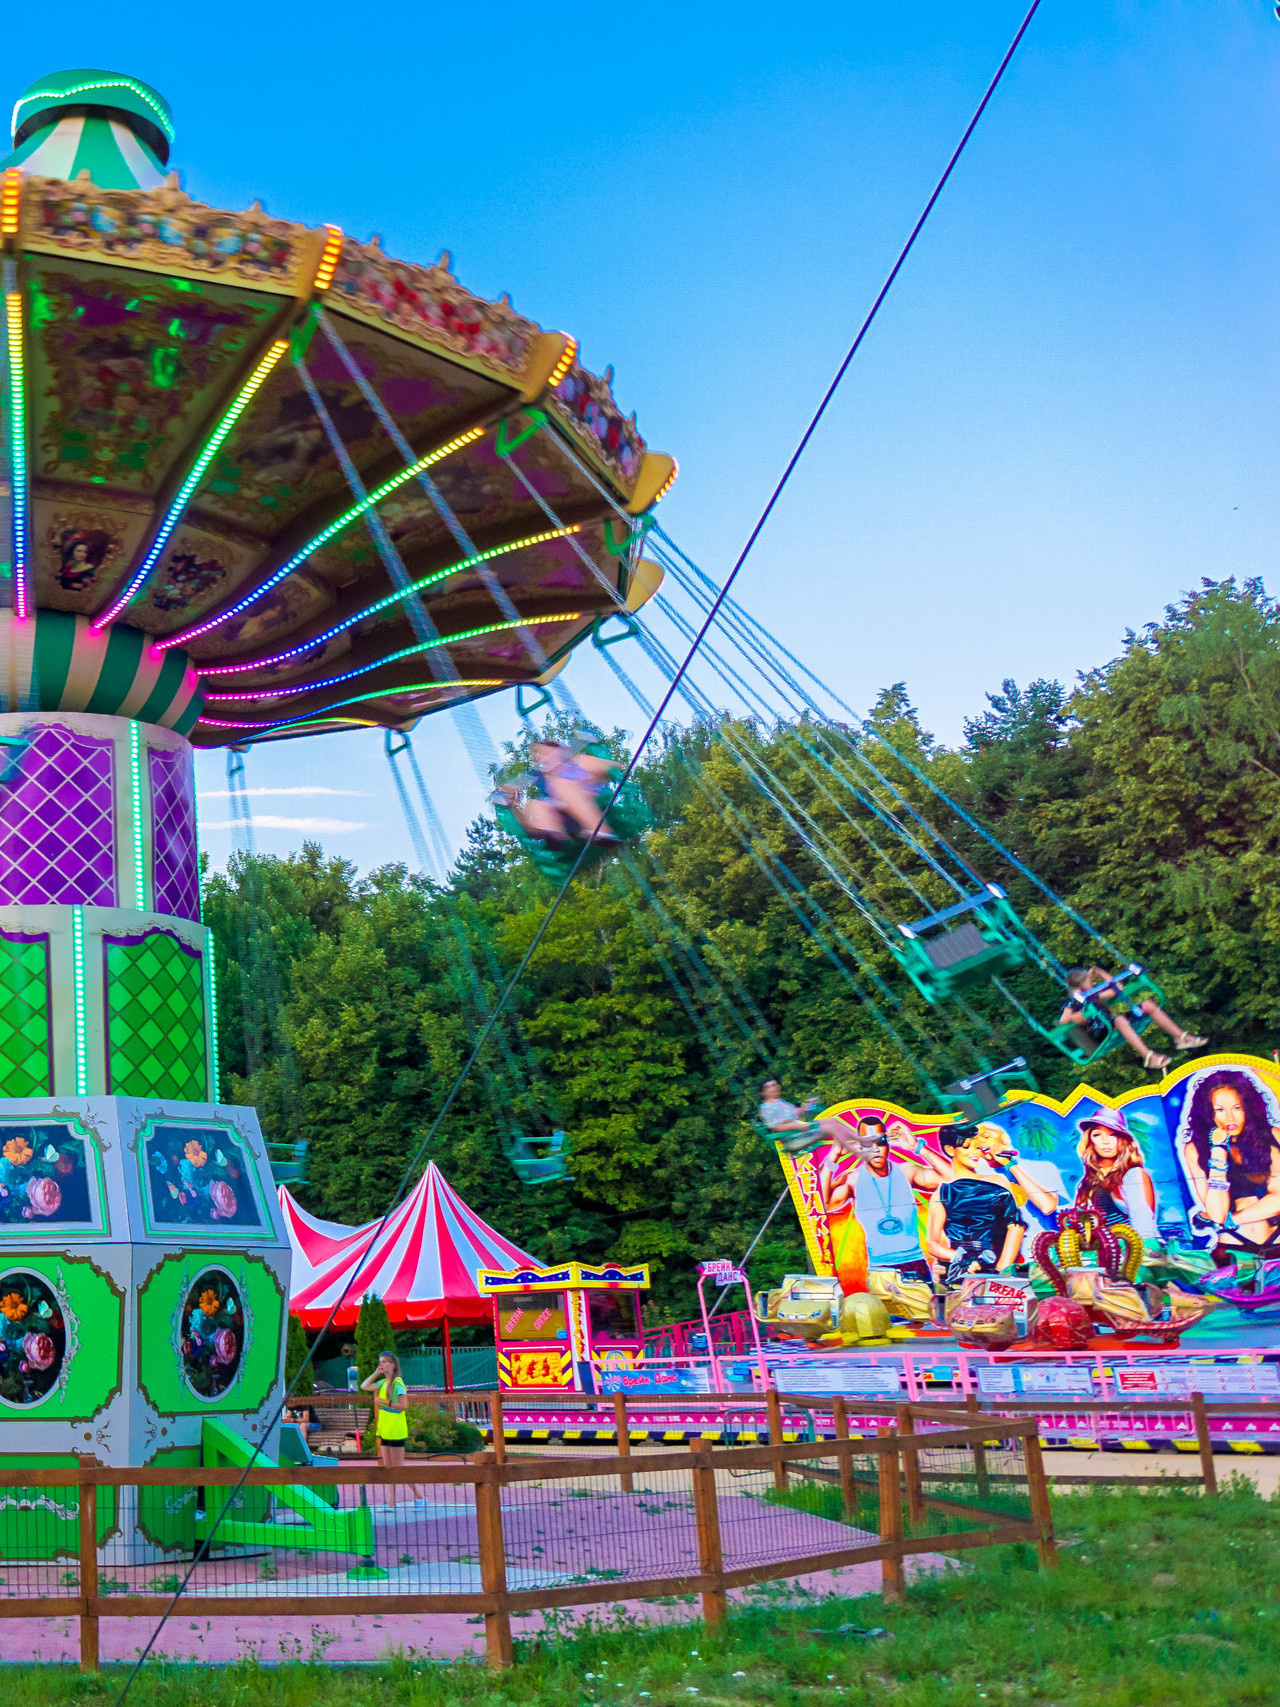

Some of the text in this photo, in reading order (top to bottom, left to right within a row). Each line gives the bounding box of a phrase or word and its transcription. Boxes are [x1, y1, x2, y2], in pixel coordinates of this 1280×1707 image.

[717, 1271, 738, 1282] ДАНС
[622, 1375, 651, 1389] Брейк
[654, 1372, 678, 1385] Данс
